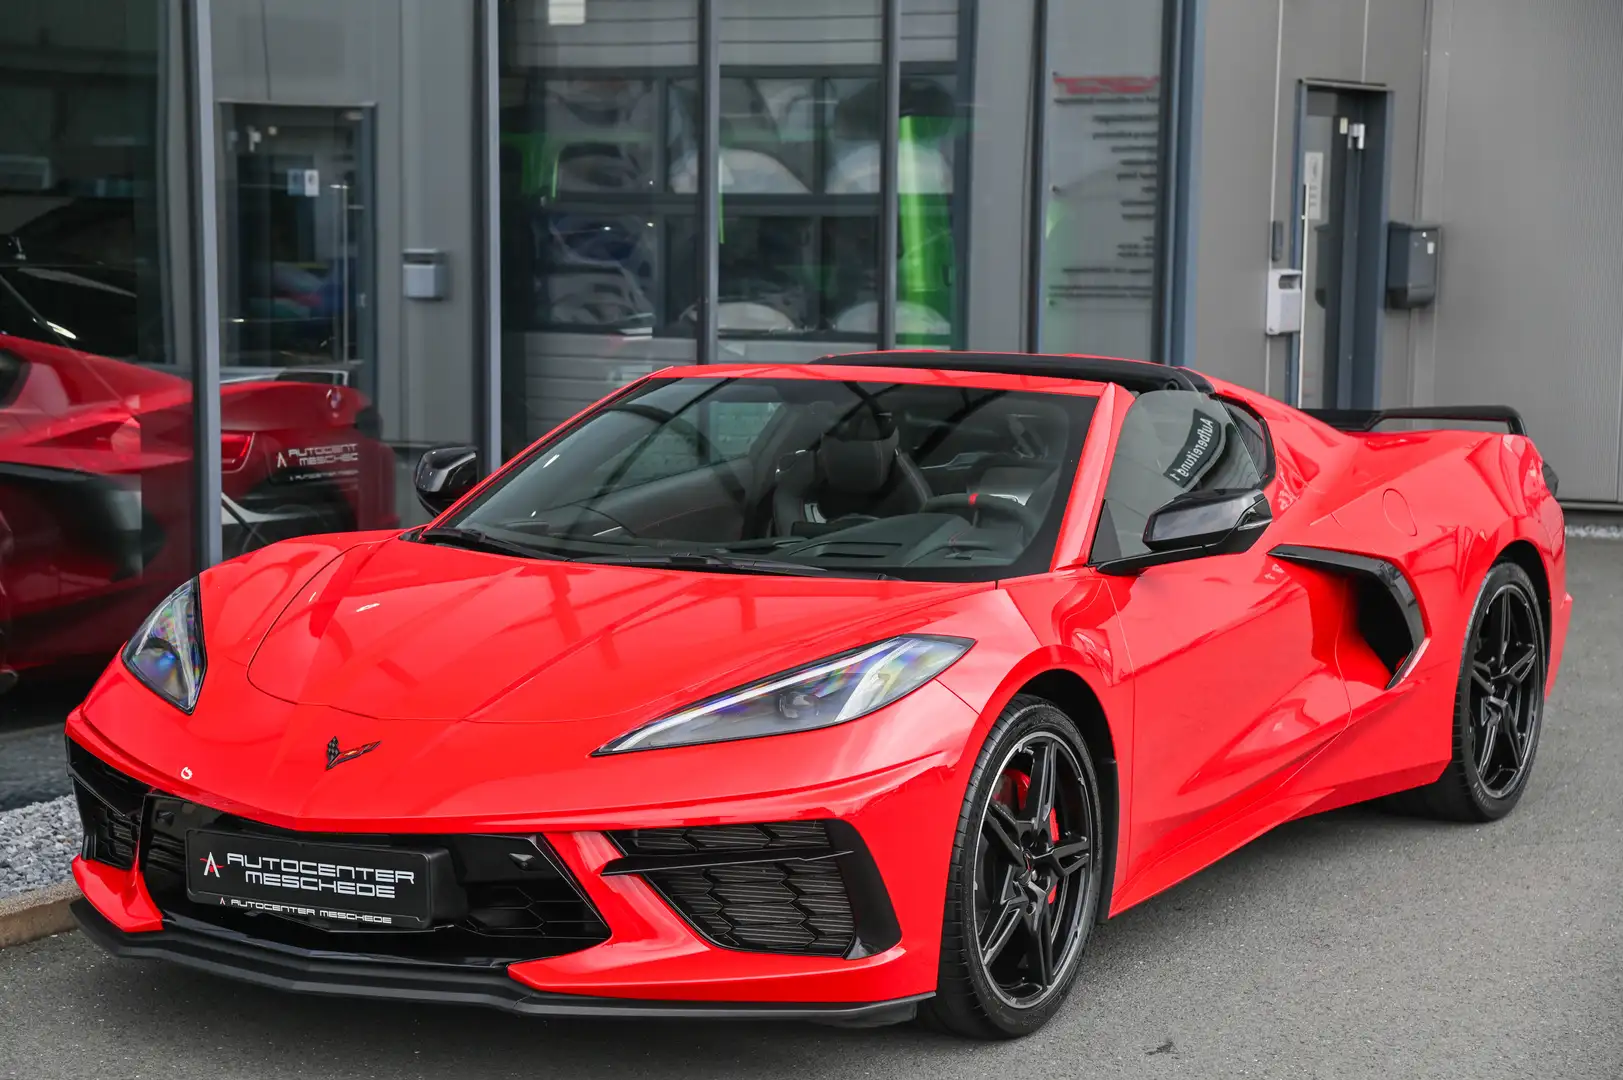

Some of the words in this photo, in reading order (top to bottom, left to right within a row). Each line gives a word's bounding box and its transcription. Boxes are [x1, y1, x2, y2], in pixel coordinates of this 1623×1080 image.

[227, 852, 415, 885] AUTOCENTER
[245, 870, 396, 899] MESCHEDE
[230, 898, 315, 916] AUTOCENTER
[319, 909, 392, 924] MESCHEDE
